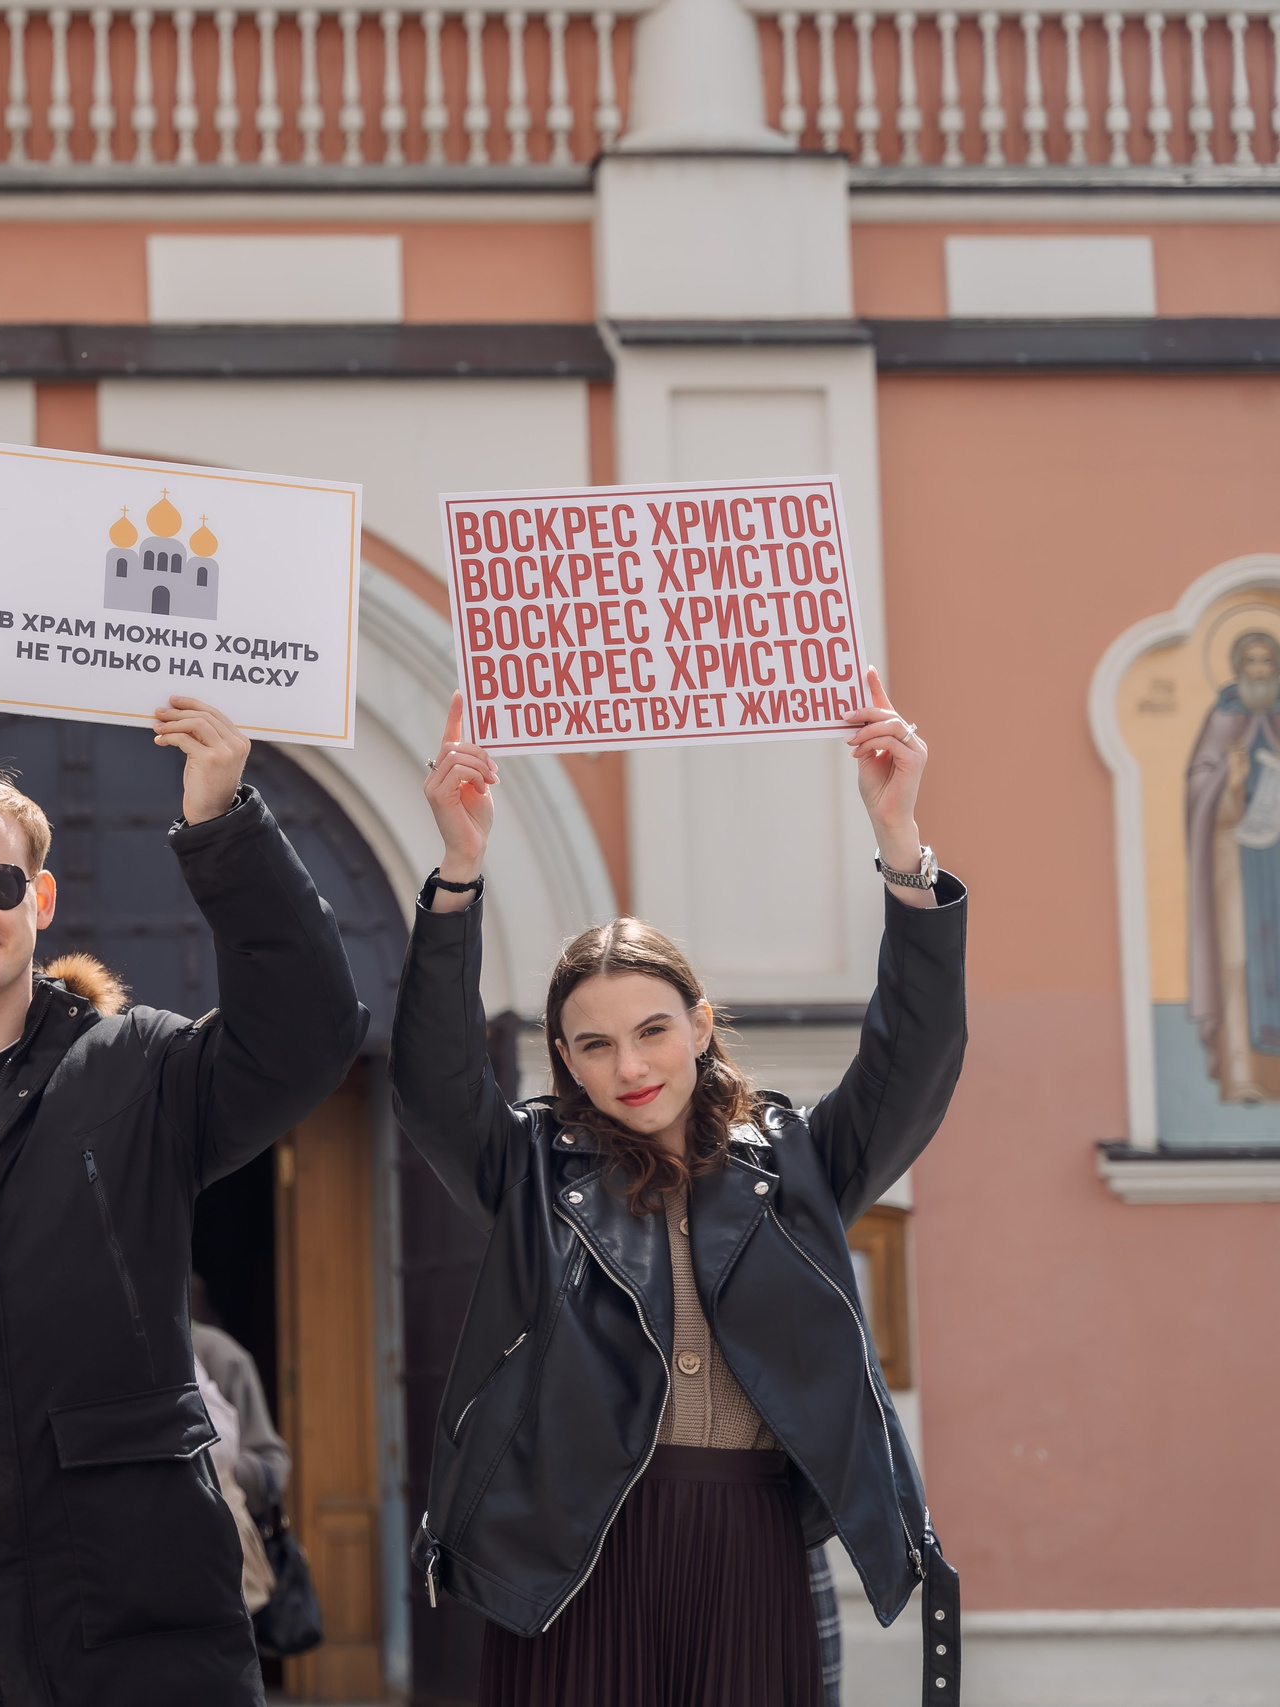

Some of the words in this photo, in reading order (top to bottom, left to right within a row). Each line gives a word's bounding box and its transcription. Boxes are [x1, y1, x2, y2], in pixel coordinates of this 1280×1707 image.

[456, 504, 637, 555] ВОСКРЕС
[647, 495, 832, 546] ХРИСТОС
[461, 551, 644, 602] ВОСКРЕС
[653, 541, 839, 594] ХРИСТОС
[21, 613, 96, 638] ХРАМ
[104, 623, 208, 650] МОЖНО
[215, 634, 319, 661] ХОДИТЬ
[467, 600, 650, 652] ВОСКРЕС
[660, 589, 846, 643] ХРИСТОС
[16, 641, 50, 661] НЕ
[57, 645, 161, 673] ТОЛЬКО
[168, 658, 204, 678] НА
[212, 662, 299, 687] ПАСХУ
[472, 647, 656, 700] ВОСКРЕС
[665, 637, 853, 691] ХРИСТОС
[476, 705, 497, 740] И
[504, 693, 728, 739] ТОРЖЕСТВУЕТ
